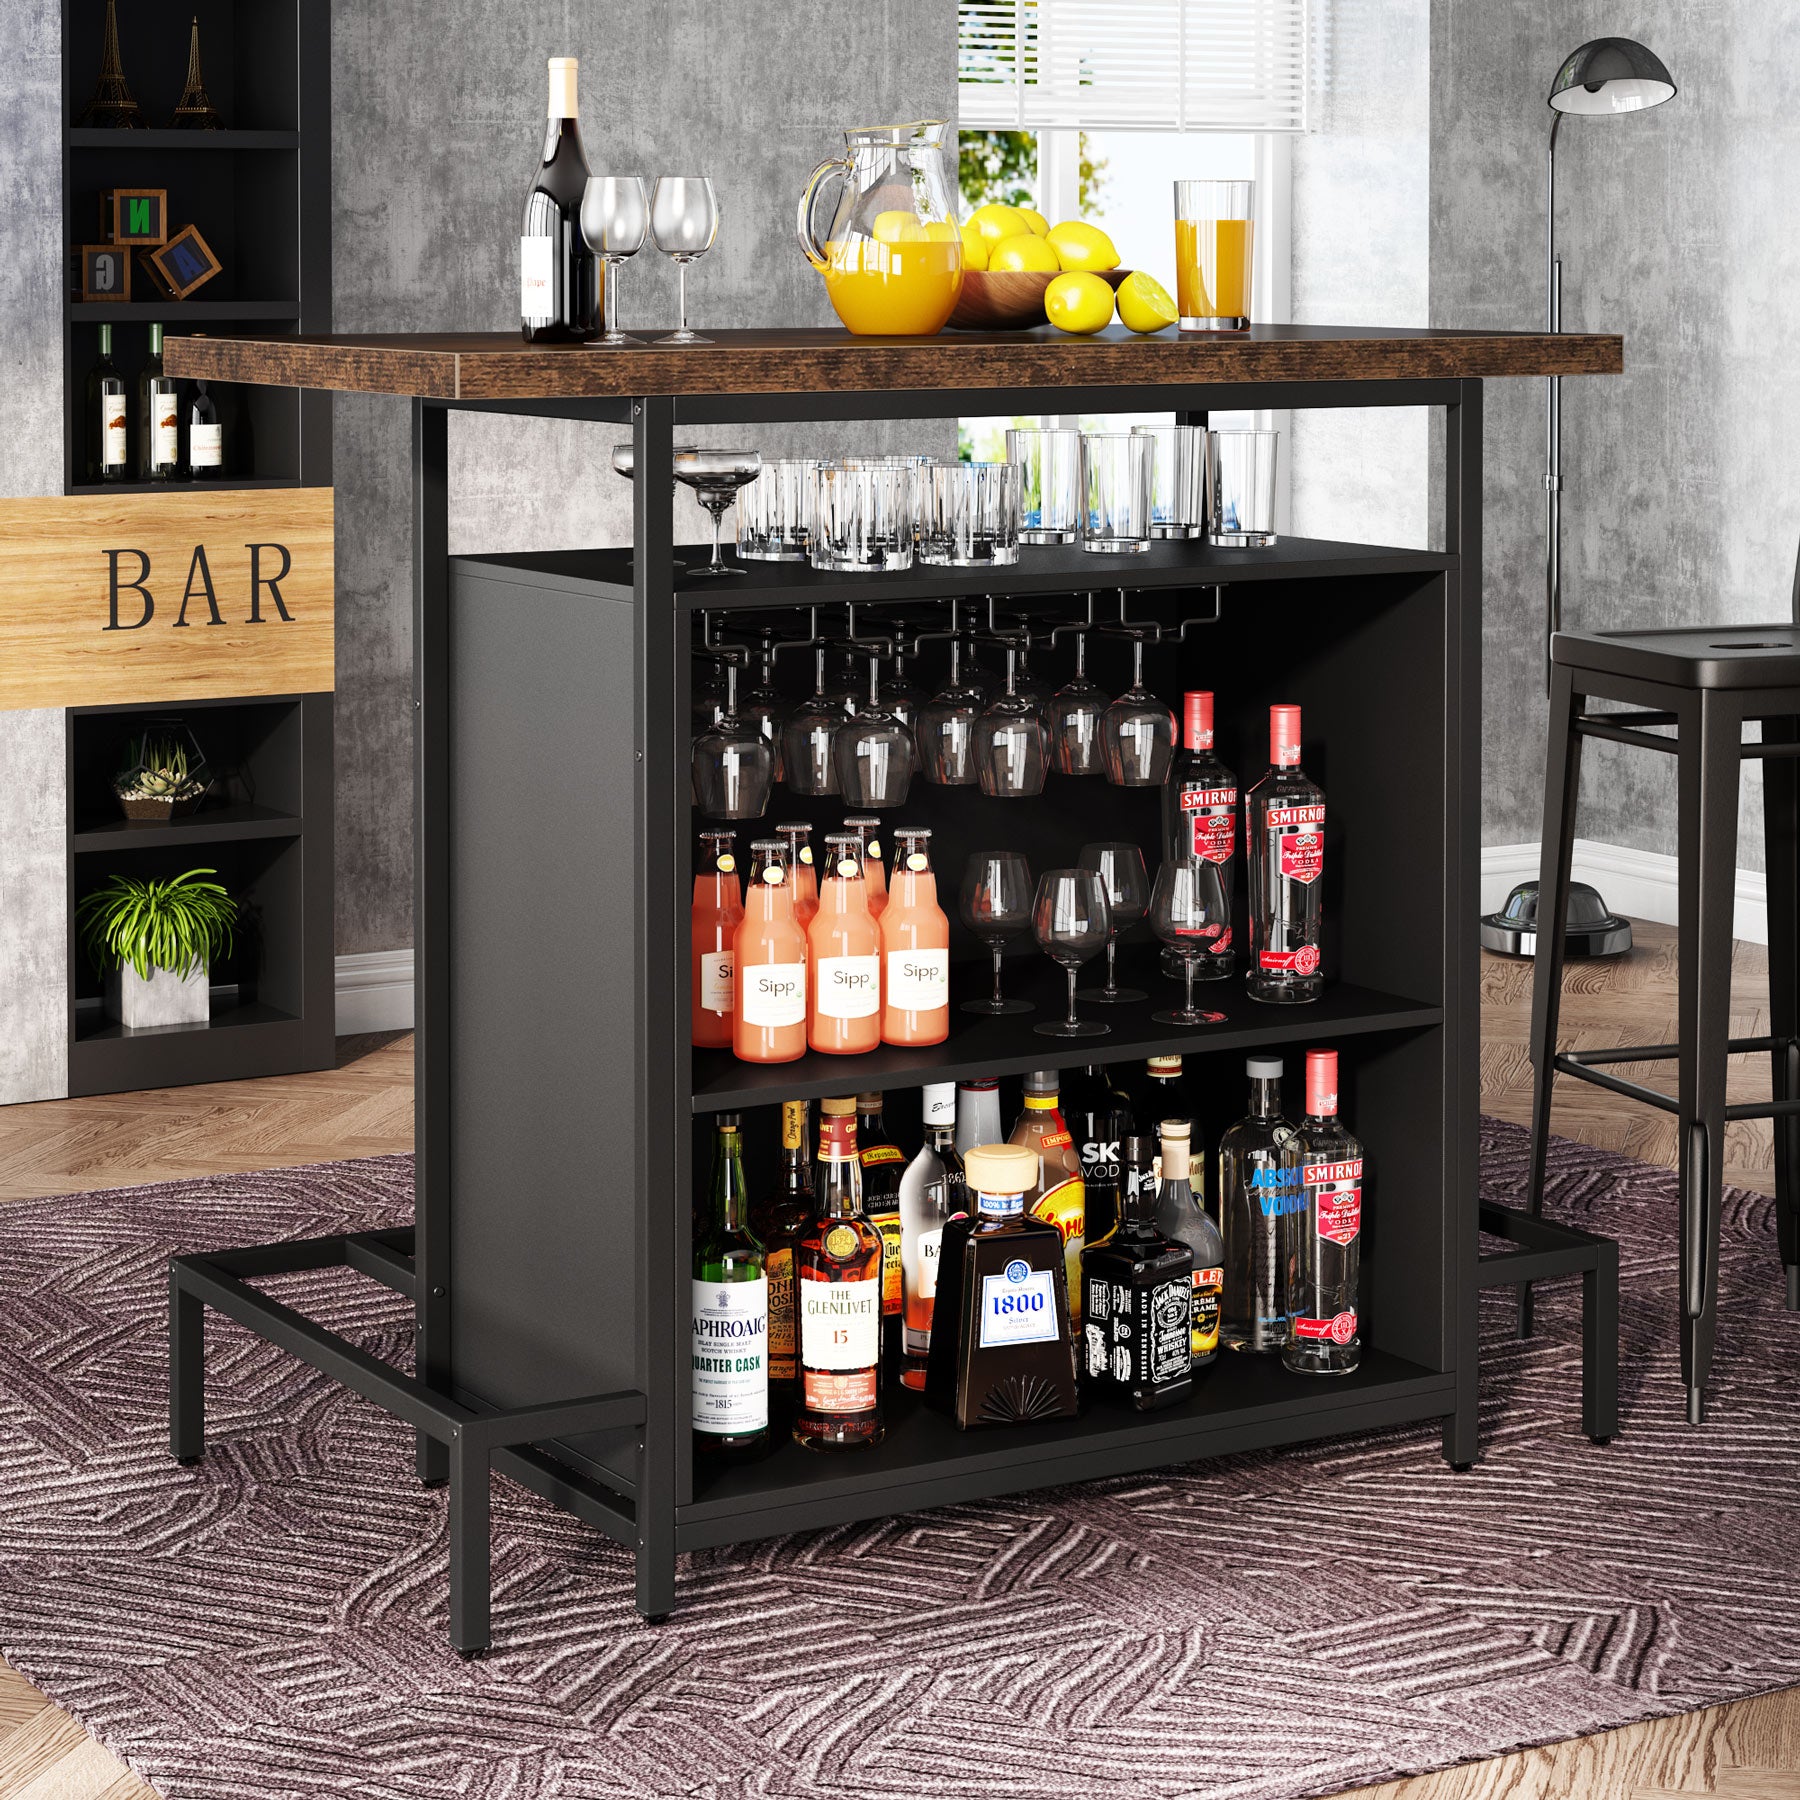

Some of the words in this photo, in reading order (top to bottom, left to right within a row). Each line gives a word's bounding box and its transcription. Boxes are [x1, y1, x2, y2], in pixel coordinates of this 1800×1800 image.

[102, 543, 296, 631] BAR
[834, 970, 870, 989] Sipp
[903, 963, 939, 982] Sipp
[758, 978, 795, 997] Sipp
[831, 1235, 851, 1245] 1824
[829, 1290, 852, 1300] THE
[992, 1292, 1044, 1316] 1800
[807, 1298, 873, 1315] GLENLIVET
[833, 1329, 848, 1344] 15
[1157, 1336, 1188, 1355] WHISKEY
[735, 1354, 761, 1373] CASK
[715, 1399, 733, 1409] 1815
